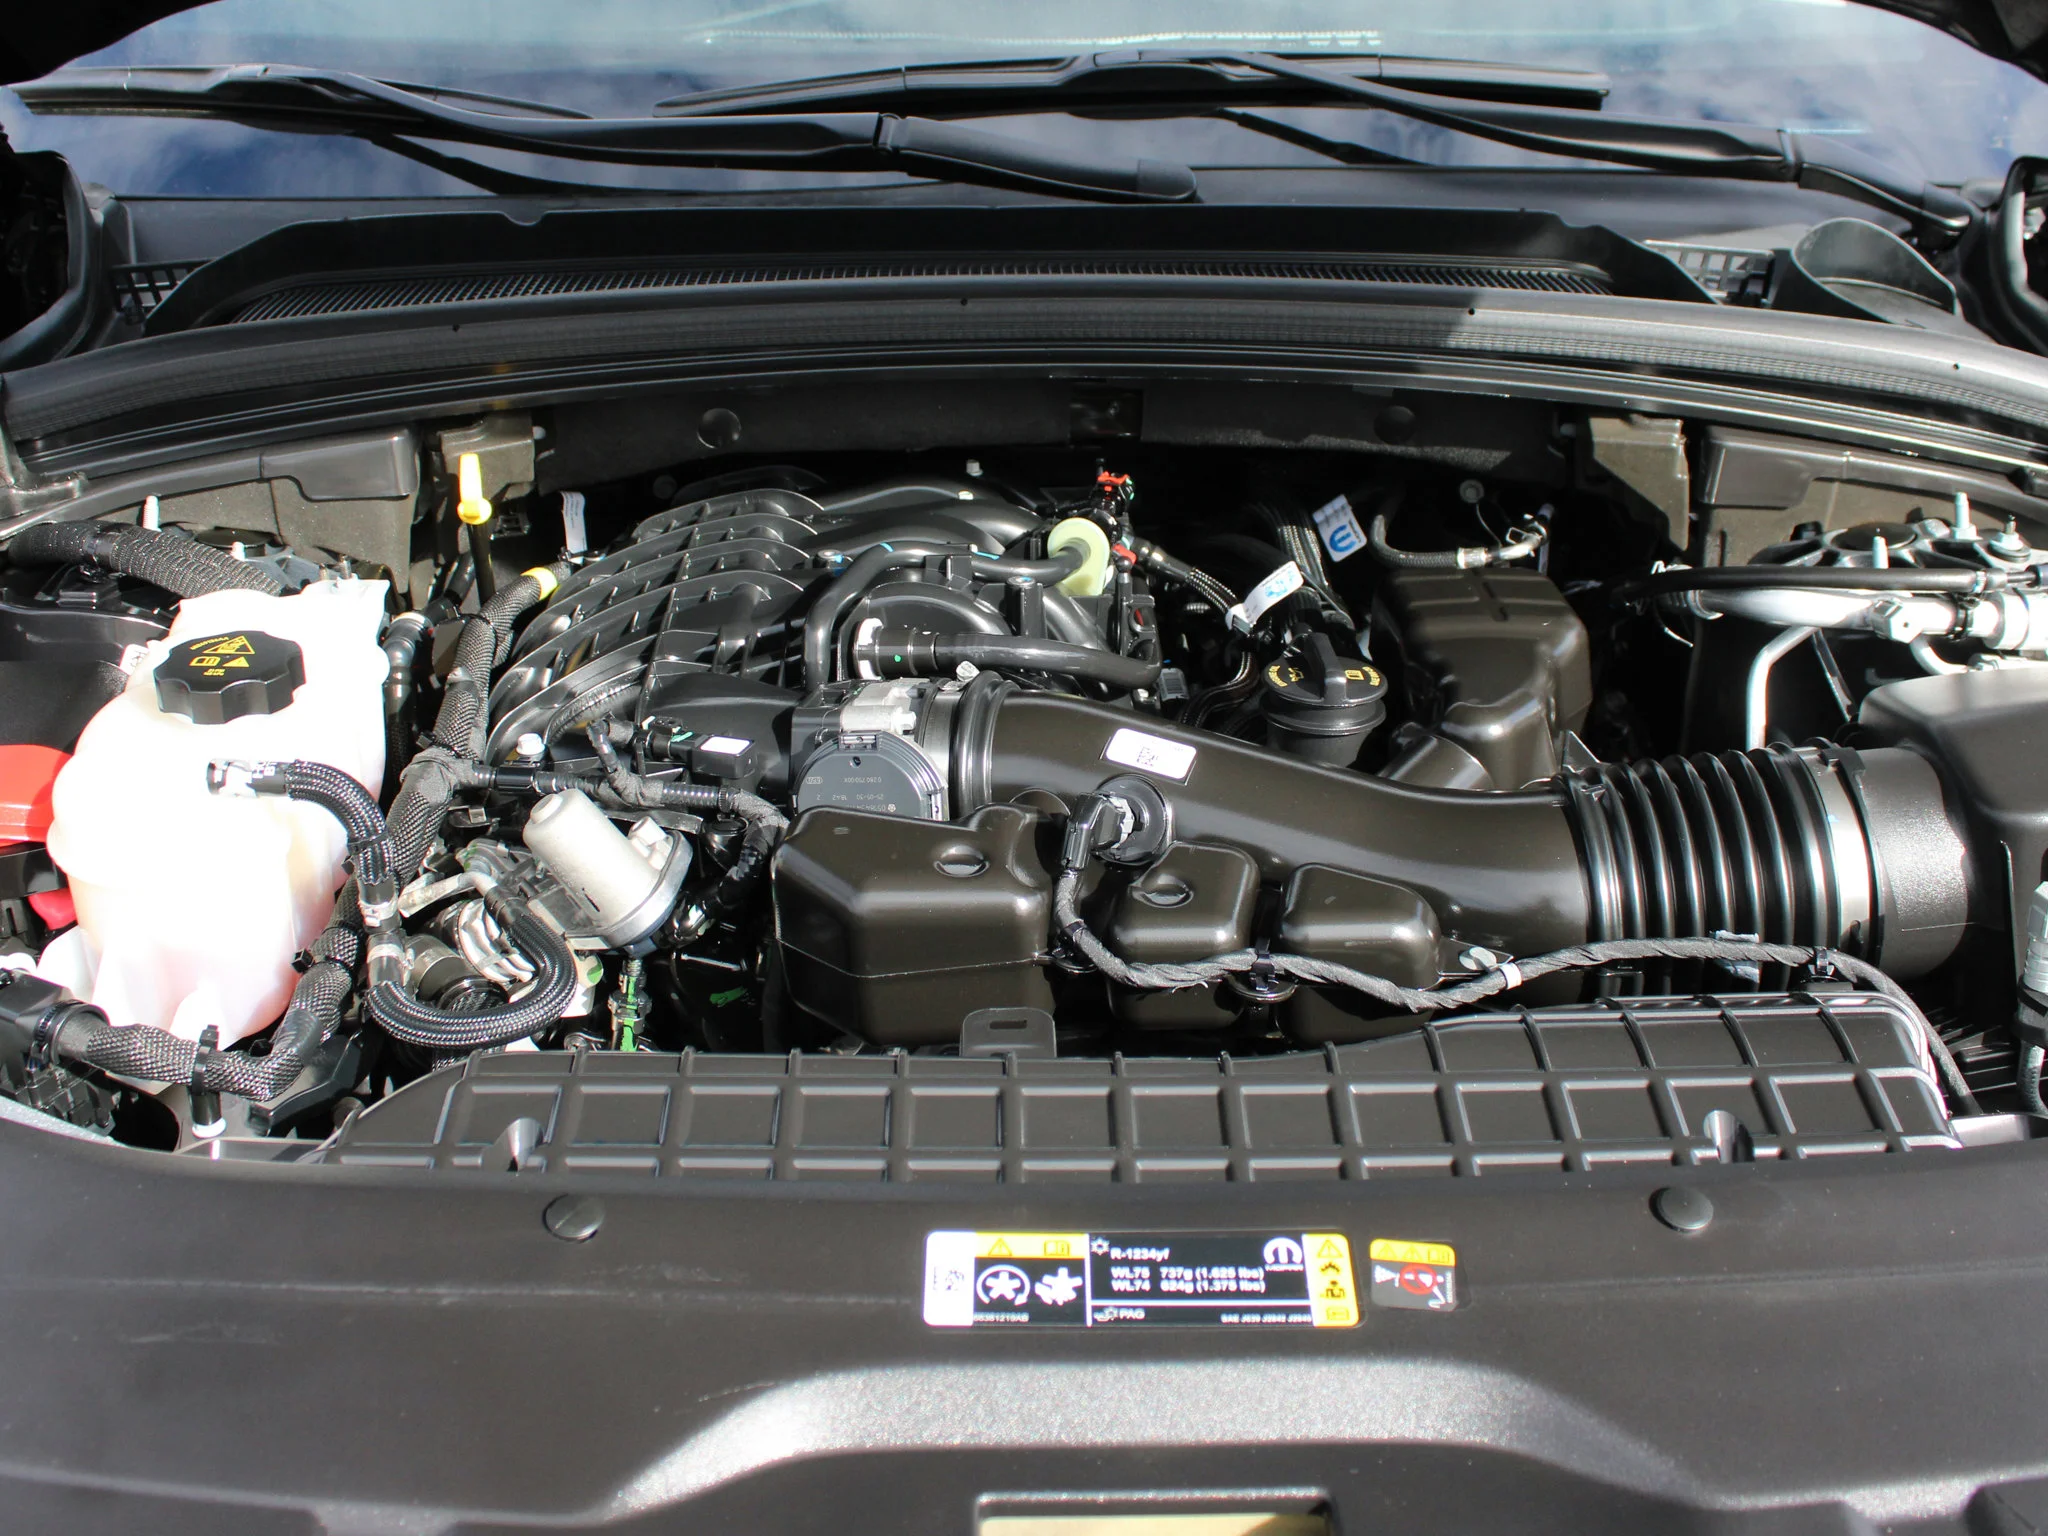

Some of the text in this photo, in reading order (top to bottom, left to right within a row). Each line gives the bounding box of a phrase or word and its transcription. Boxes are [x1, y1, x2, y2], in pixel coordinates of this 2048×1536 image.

[1110, 1247, 1169, 1262] R-1234yf
[1111, 1266, 1264, 1281] WL75 737g (1.625 lbs)
[1111, 1279, 1266, 1294] WL74 624g (1.375 lbs)
[1119, 1308, 1145, 1319] PAG
